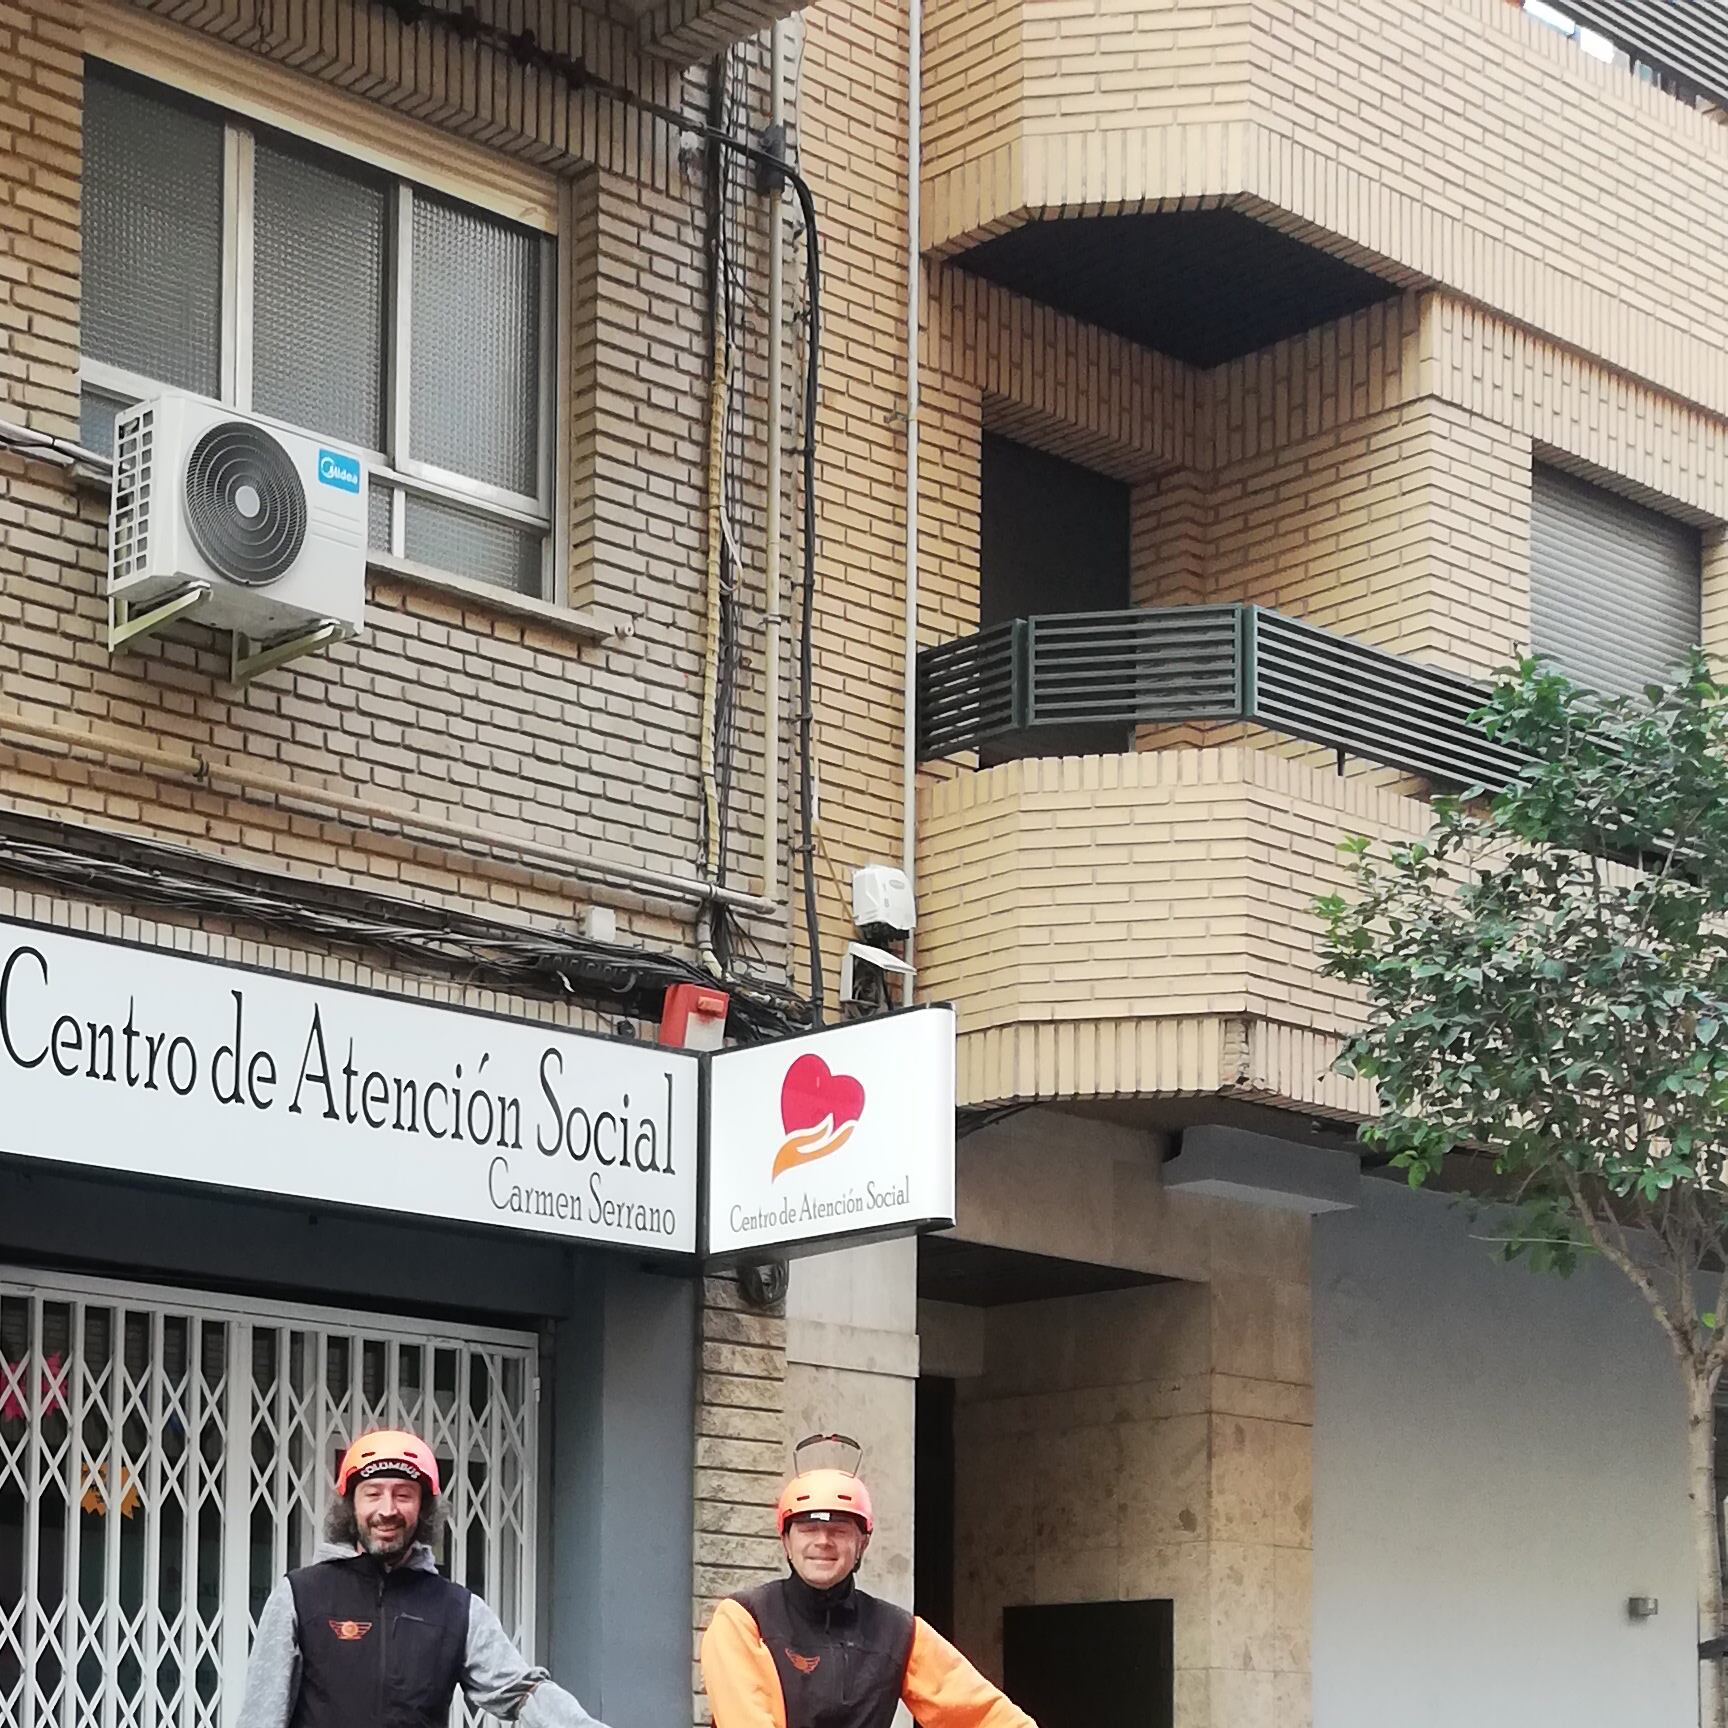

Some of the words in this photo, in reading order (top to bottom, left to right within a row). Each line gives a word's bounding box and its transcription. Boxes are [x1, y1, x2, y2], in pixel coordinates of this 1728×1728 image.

[320, 457, 358, 485] Midea
[212, 990, 276, 1112] de
[289, 1002, 523, 1150] Atención
[537, 1047, 678, 1177] Social
[487, 1157, 583, 1223] Carmen
[588, 1171, 677, 1238] Serrano
[730, 1204, 777, 1233] Centro
[779, 1197, 796, 1224] de
[799, 1189, 863, 1222] Atención
[867, 1175, 910, 1210] Social
